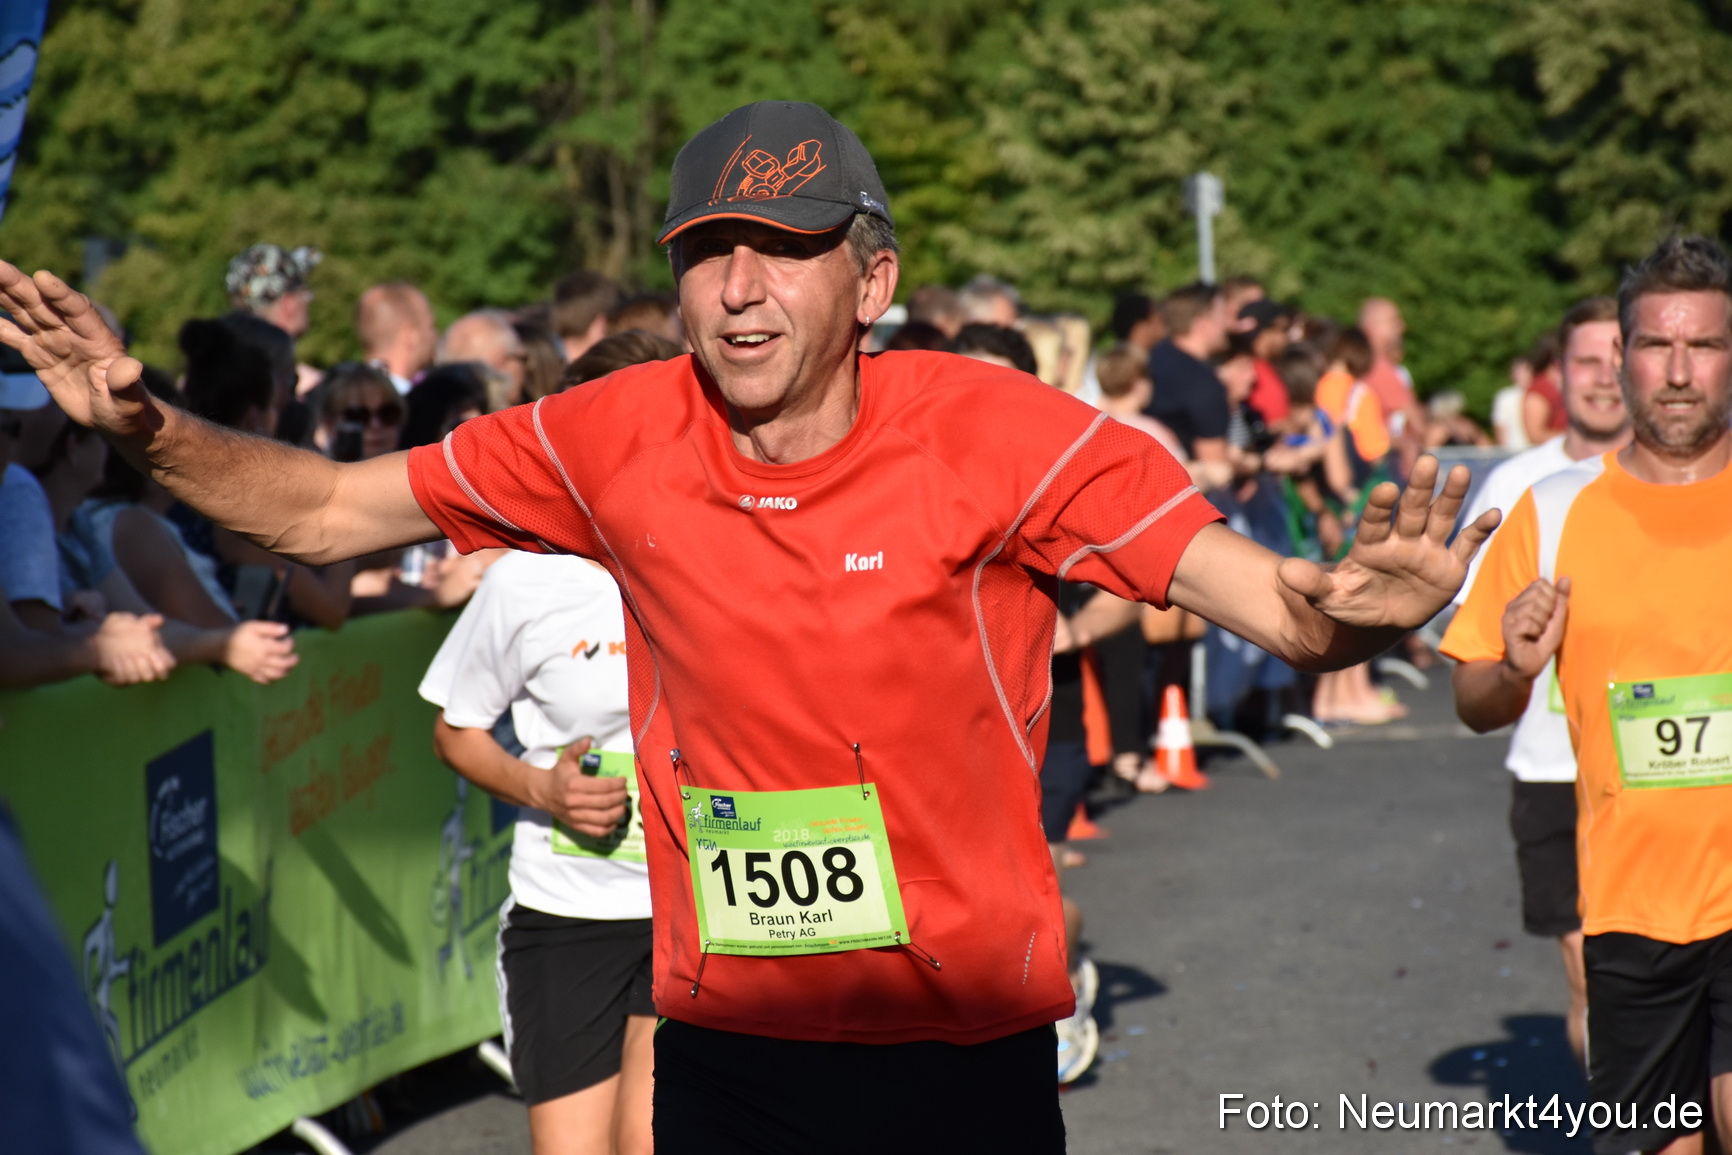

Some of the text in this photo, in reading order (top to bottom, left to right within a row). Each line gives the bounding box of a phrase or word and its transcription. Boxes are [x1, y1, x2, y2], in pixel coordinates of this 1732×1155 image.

[757, 497, 798, 510] JAKO
[845, 551, 883, 572] Karl
[1656, 716, 1711, 757] 97
[703, 814, 762, 831] firmenlauf
[773, 827, 811, 843] 2018
[711, 846, 864, 908] 1508
[749, 908, 833, 926] Braun Karl
[768, 927, 817, 941] Petry AG
